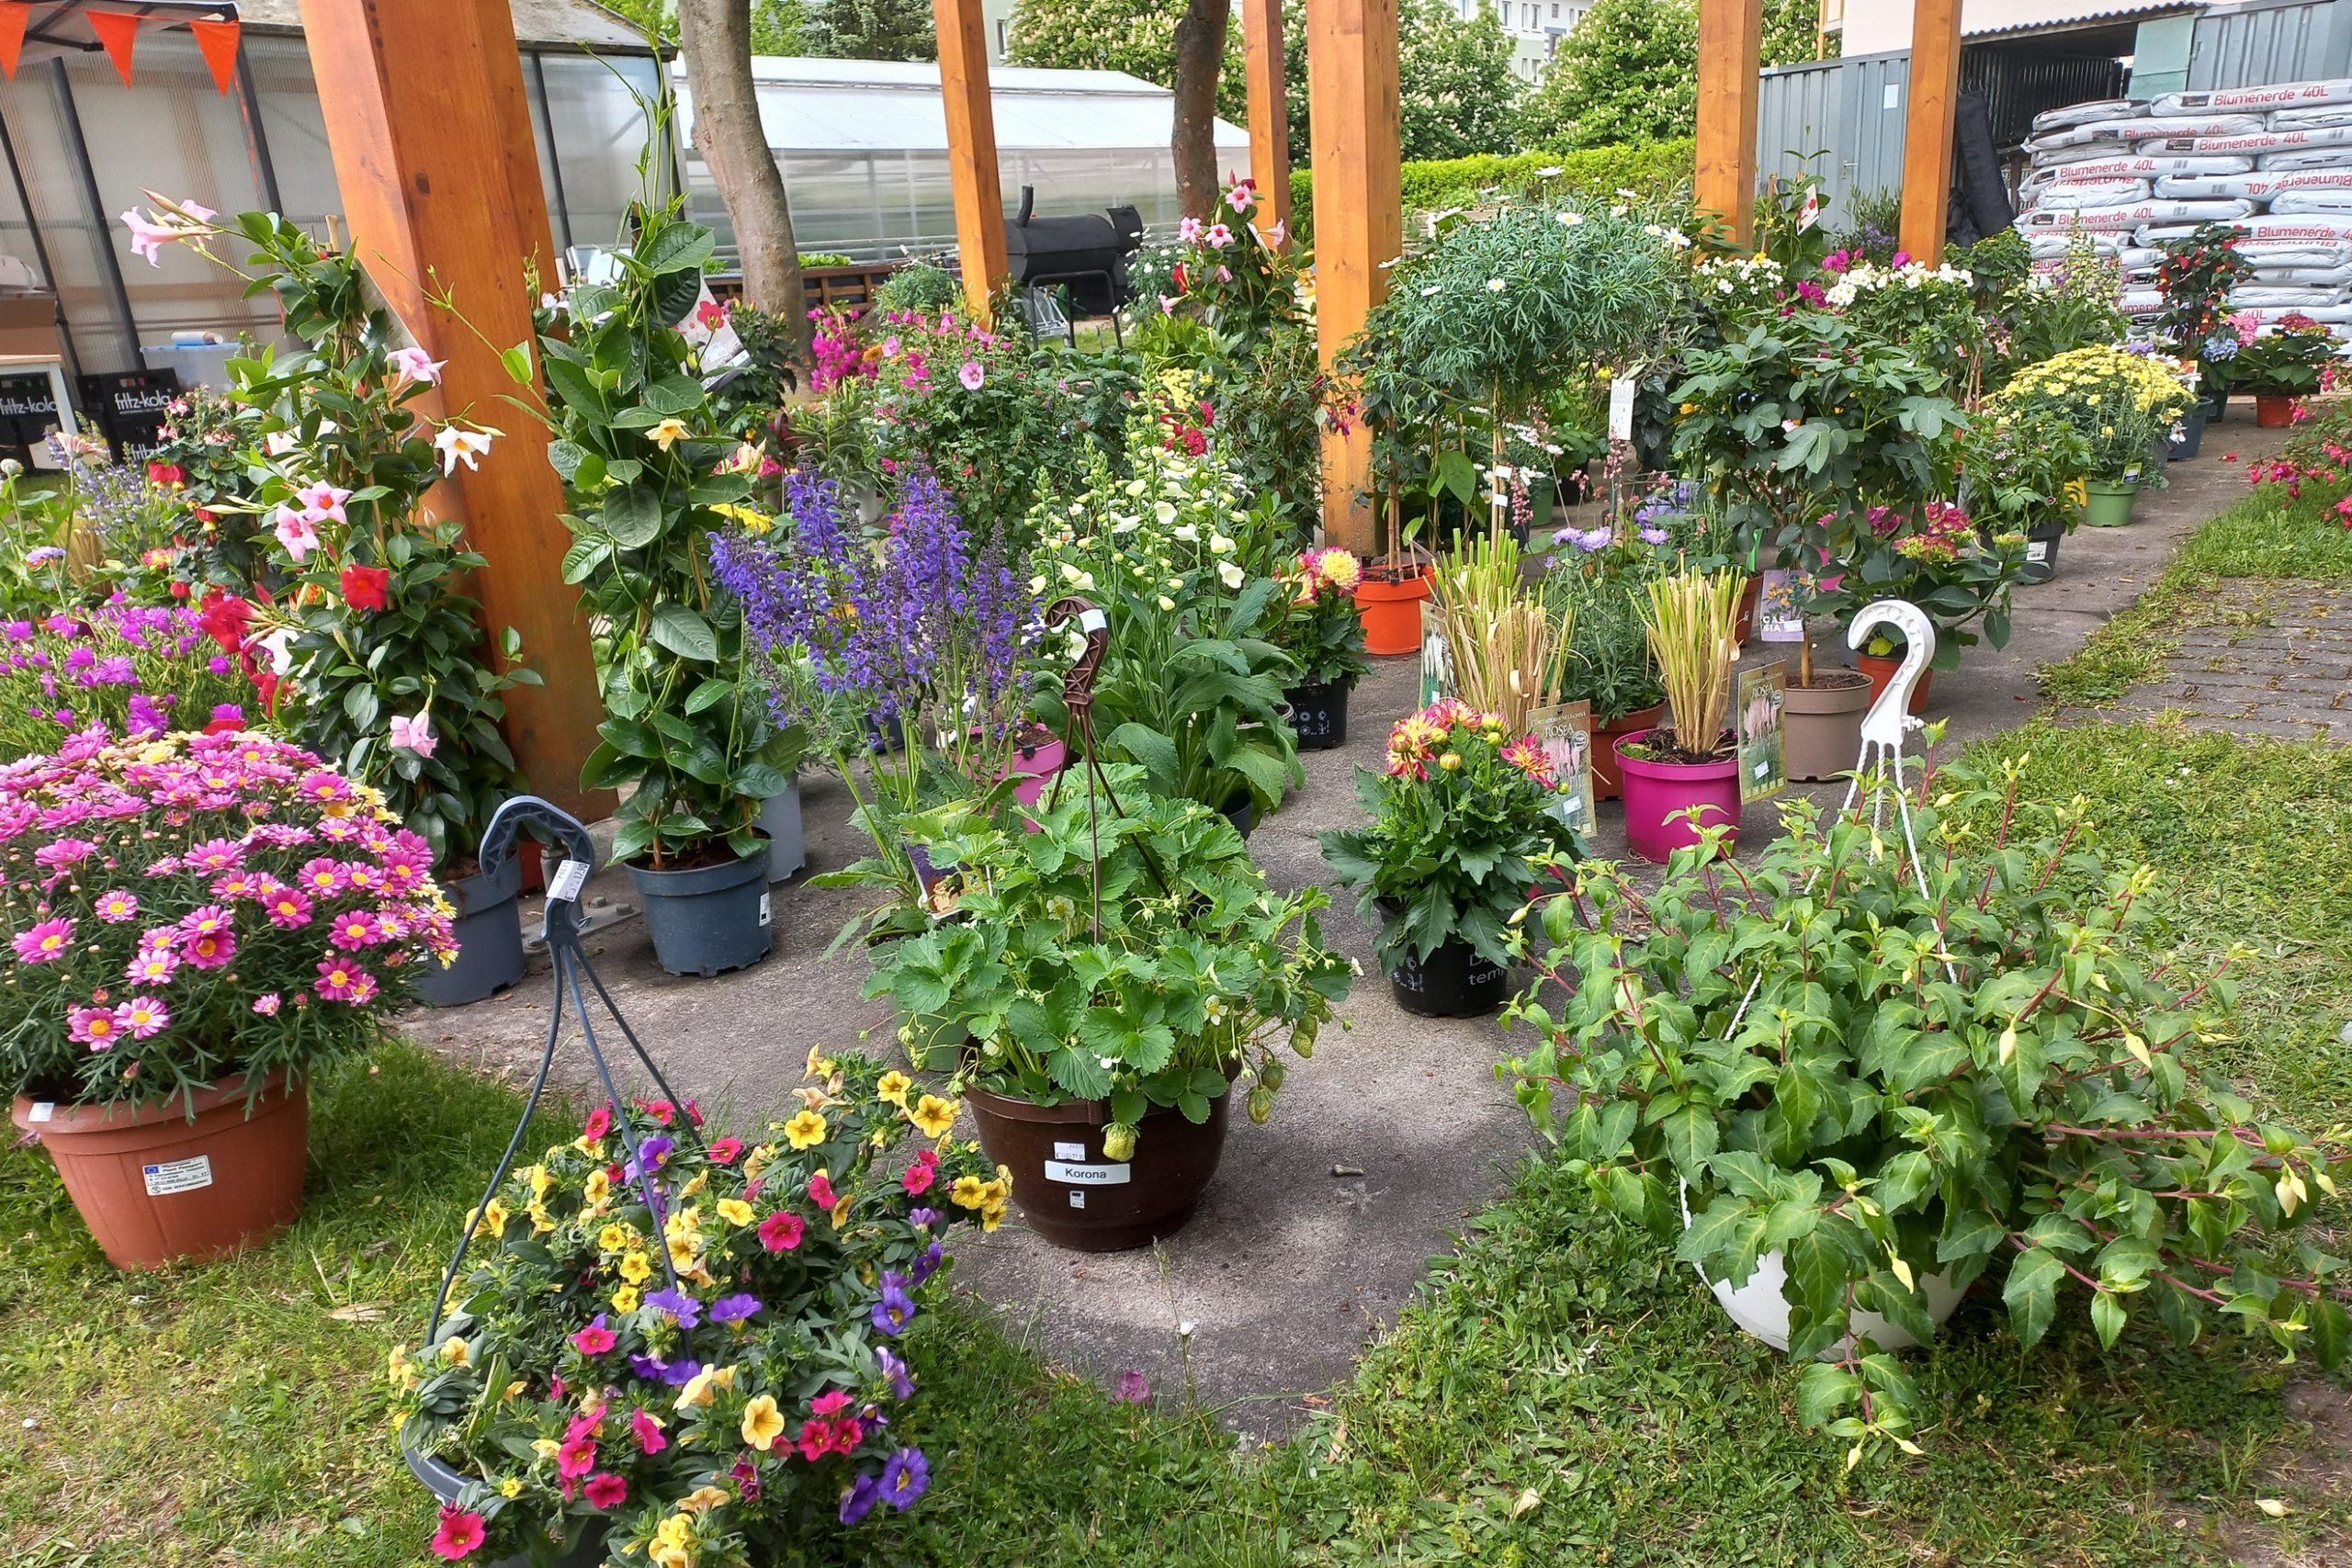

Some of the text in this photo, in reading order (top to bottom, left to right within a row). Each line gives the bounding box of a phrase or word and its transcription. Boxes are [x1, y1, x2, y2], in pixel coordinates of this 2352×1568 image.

[2213, 90, 2295, 107] Blumenerde
[2301, 85, 2329, 98] 40L
[2199, 131, 2309, 151] Blumenerde 40L
[2060, 162, 2128, 178] Blumenerde
[2133, 160, 2155, 171] 40L
[2245, 183, 2269, 195] 40L
[2133, 208, 2155, 219] 40L
[2256, 226, 2336, 238] Blumenerde
[115, 389, 171, 411] fritz-kola
[1545, 722, 1575, 738] ROSEA
[1065, 1168, 1107, 1179] Korona
